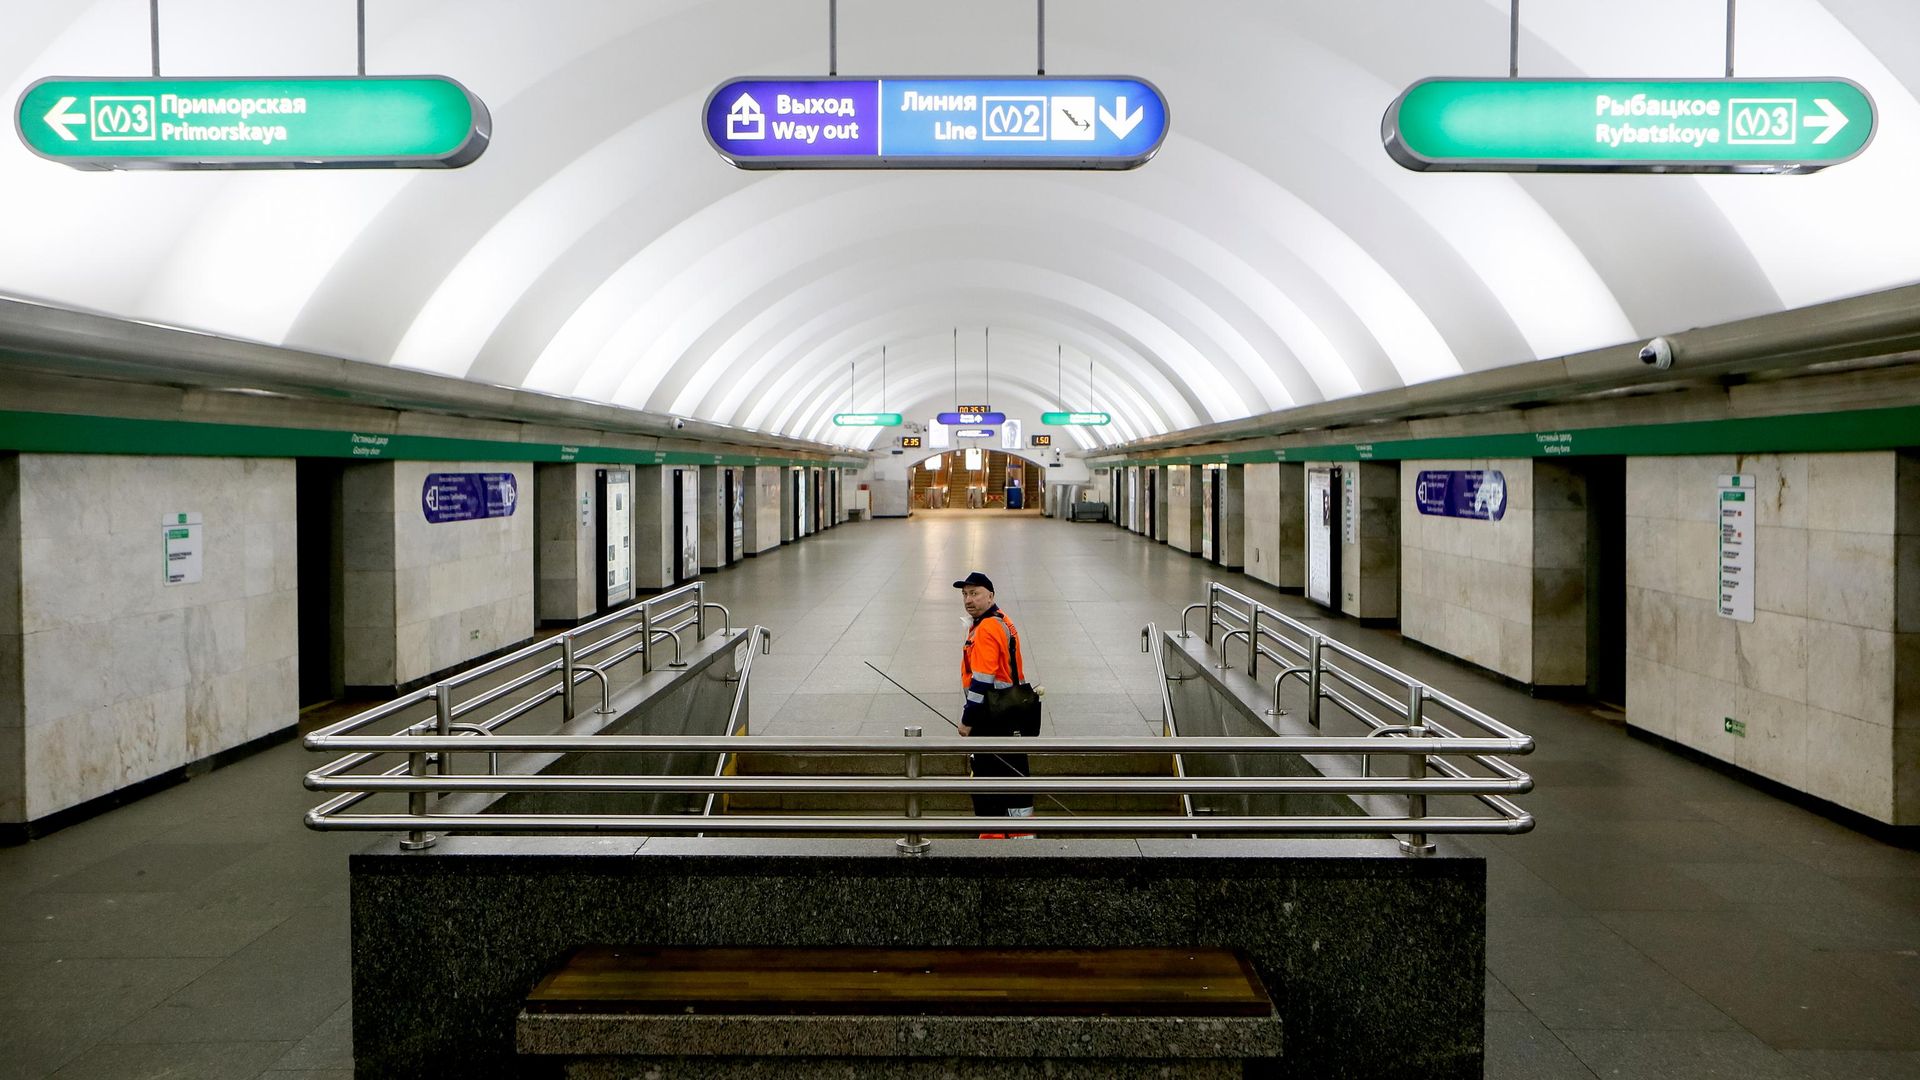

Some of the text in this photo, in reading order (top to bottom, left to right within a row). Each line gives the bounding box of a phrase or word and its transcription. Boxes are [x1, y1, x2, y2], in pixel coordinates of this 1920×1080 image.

[162, 94, 306, 118] Приморская
[777, 94, 855, 117] Выход
[900, 91, 978, 112] Линия
[1596, 94, 1721, 118] Рыбацкое
[162, 122, 287, 145] Primorskaya
[772, 122, 859, 144] Way out
[934, 121, 978, 141] Line
[1596, 122, 1721, 147] Rybatskoye
